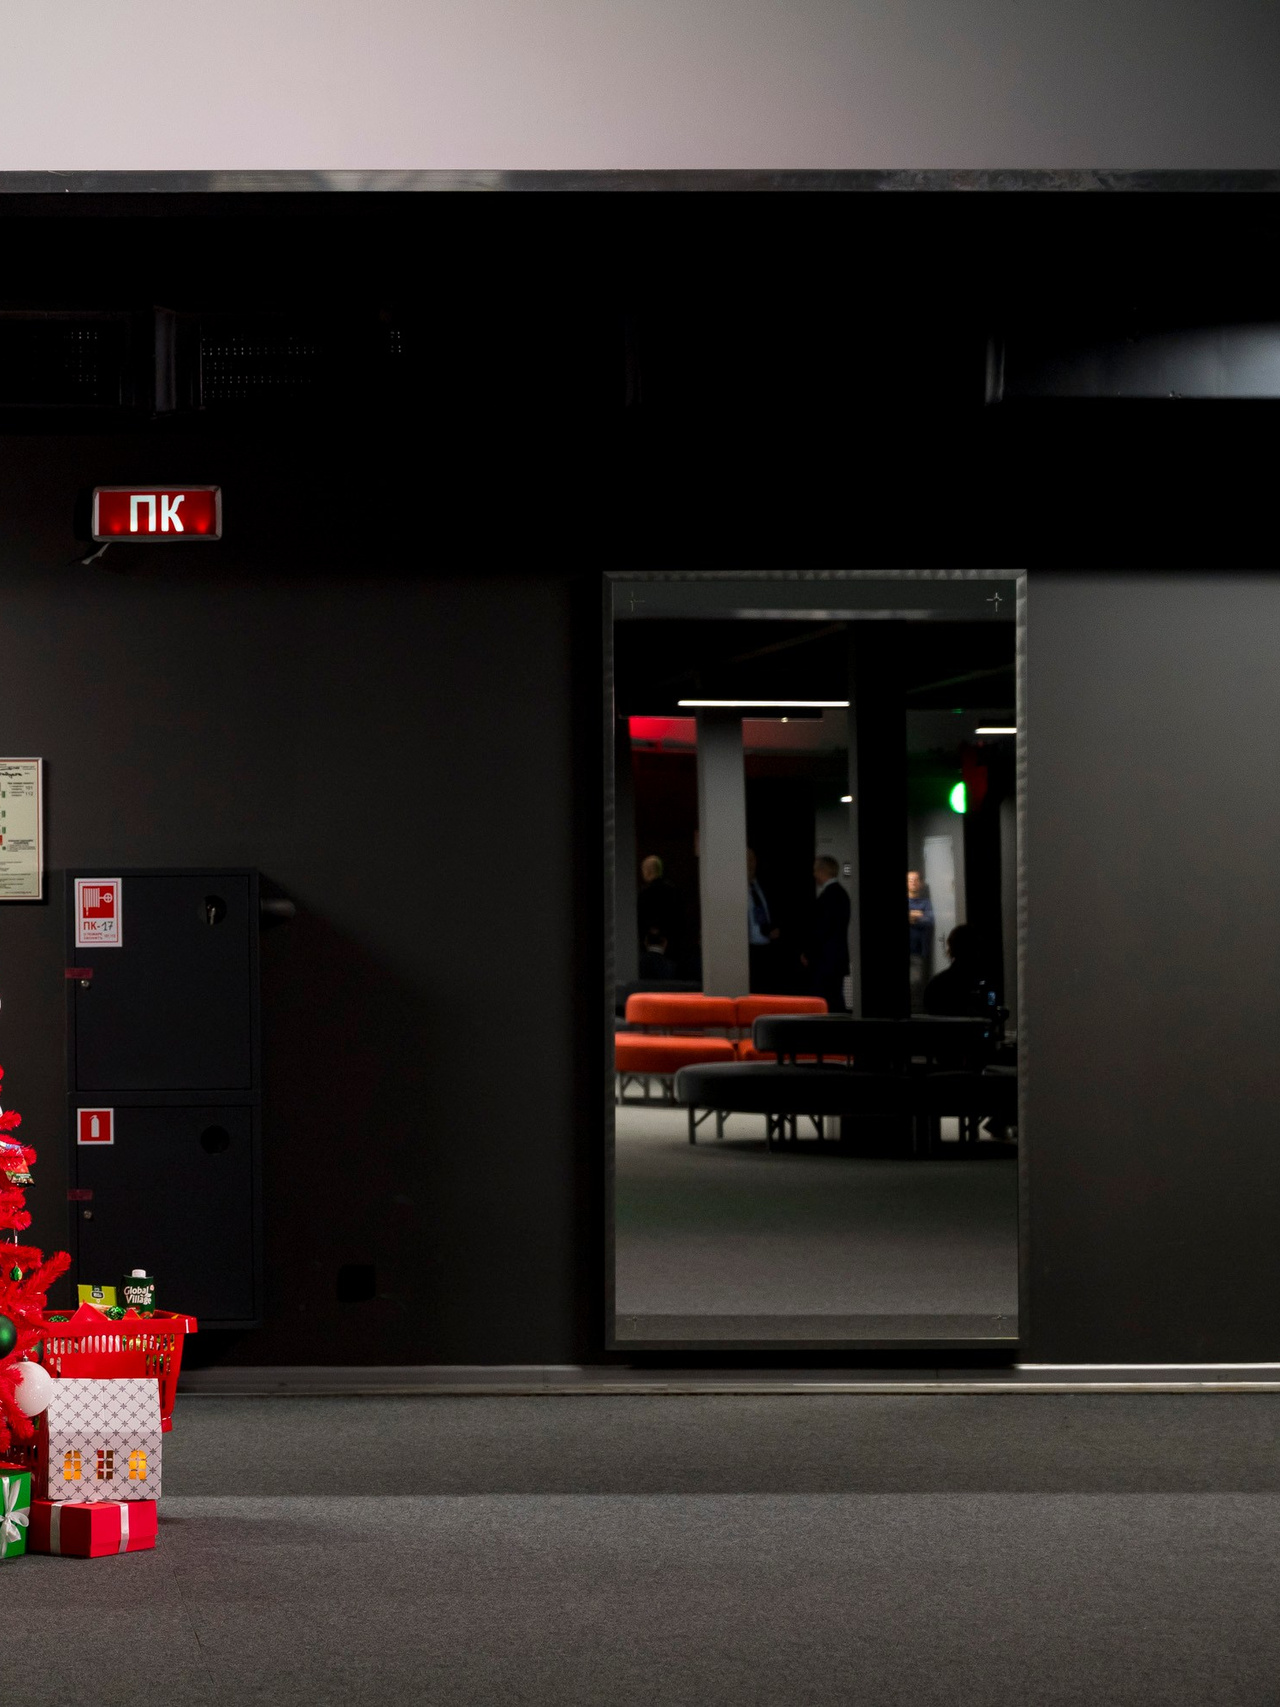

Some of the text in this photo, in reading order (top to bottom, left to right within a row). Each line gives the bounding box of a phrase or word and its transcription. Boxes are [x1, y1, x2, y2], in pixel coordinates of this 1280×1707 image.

[130, 494, 185, 532] ПК
[124, 1286, 150, 1296] Global
[125, 1294, 152, 1305] Village
